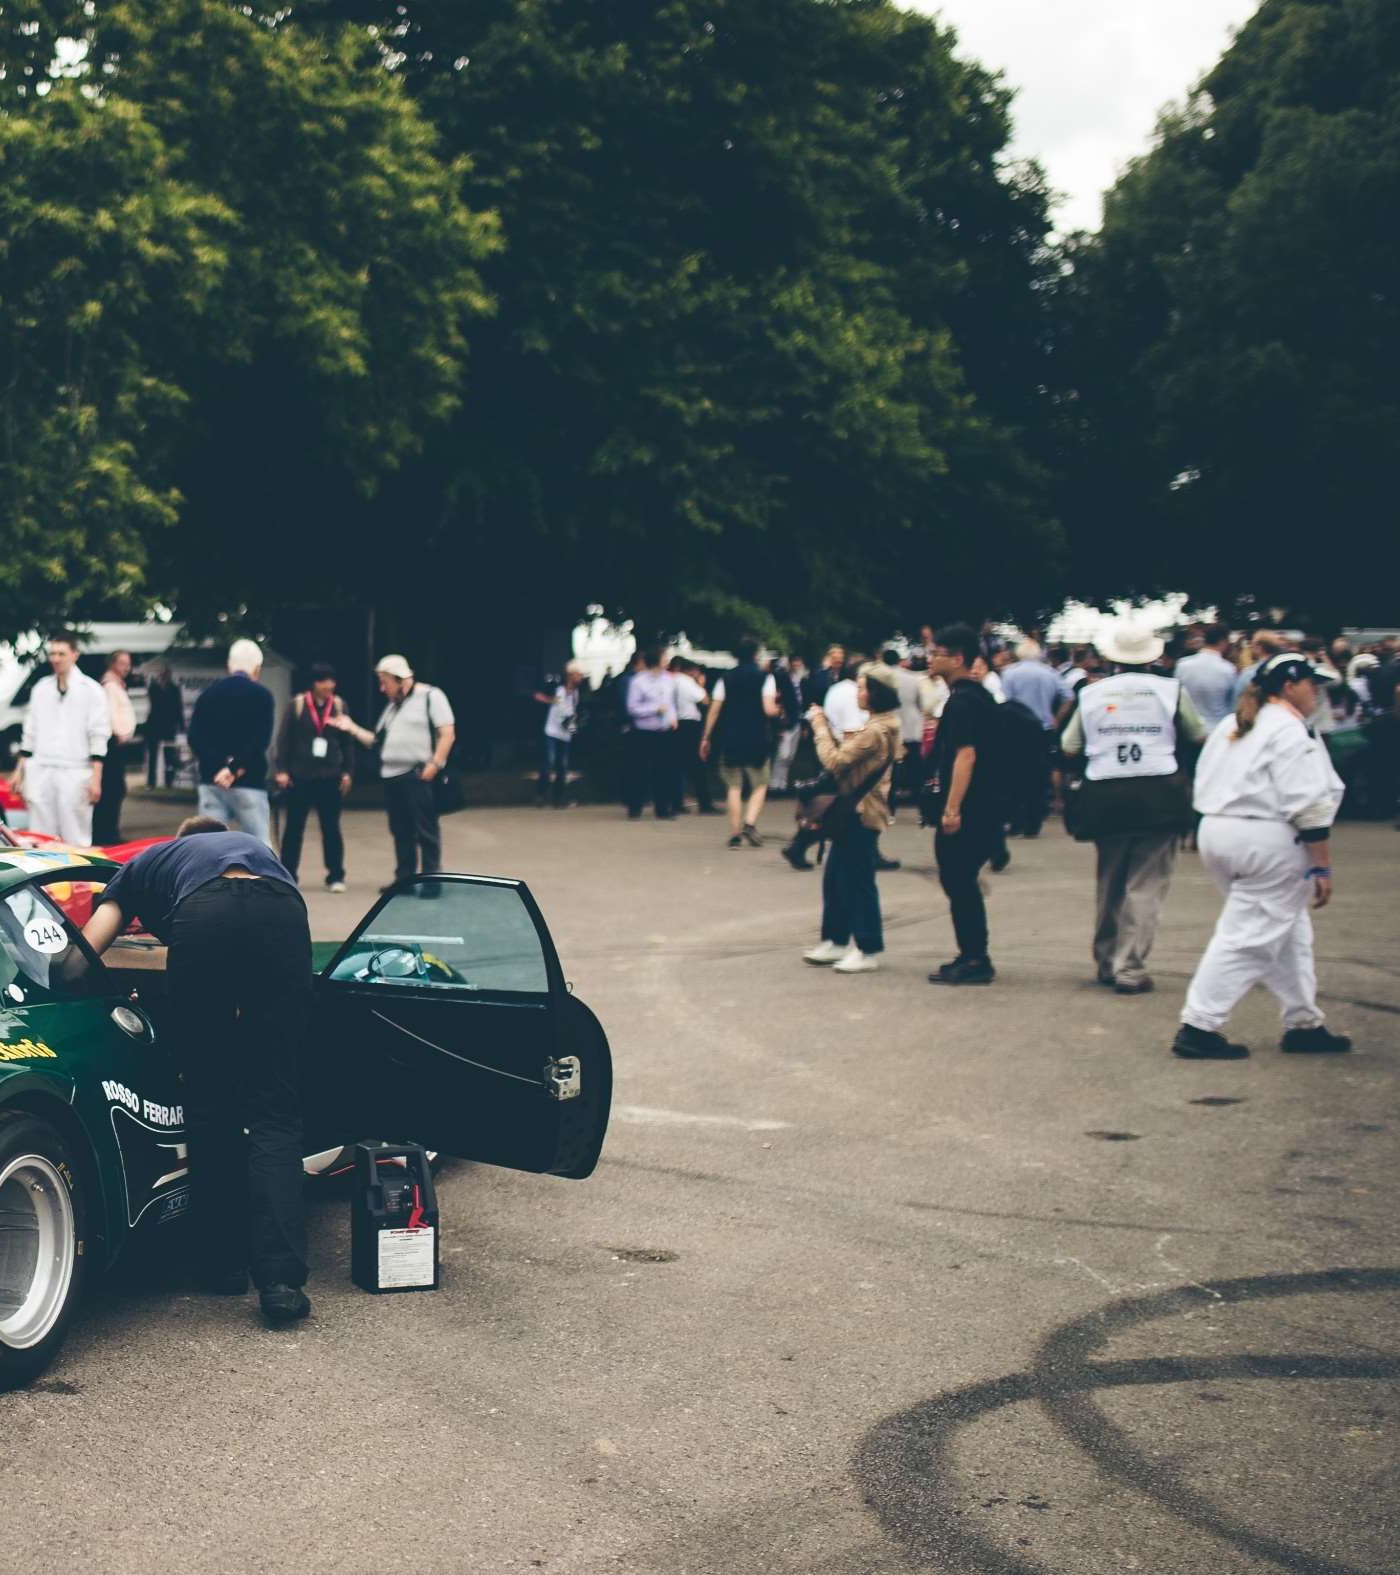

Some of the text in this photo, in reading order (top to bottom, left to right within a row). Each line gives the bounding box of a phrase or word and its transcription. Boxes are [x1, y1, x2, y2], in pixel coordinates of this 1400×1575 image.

[31, 926, 61, 946] 244
[101, 1079, 184, 1126] ROSSO FERRAR
